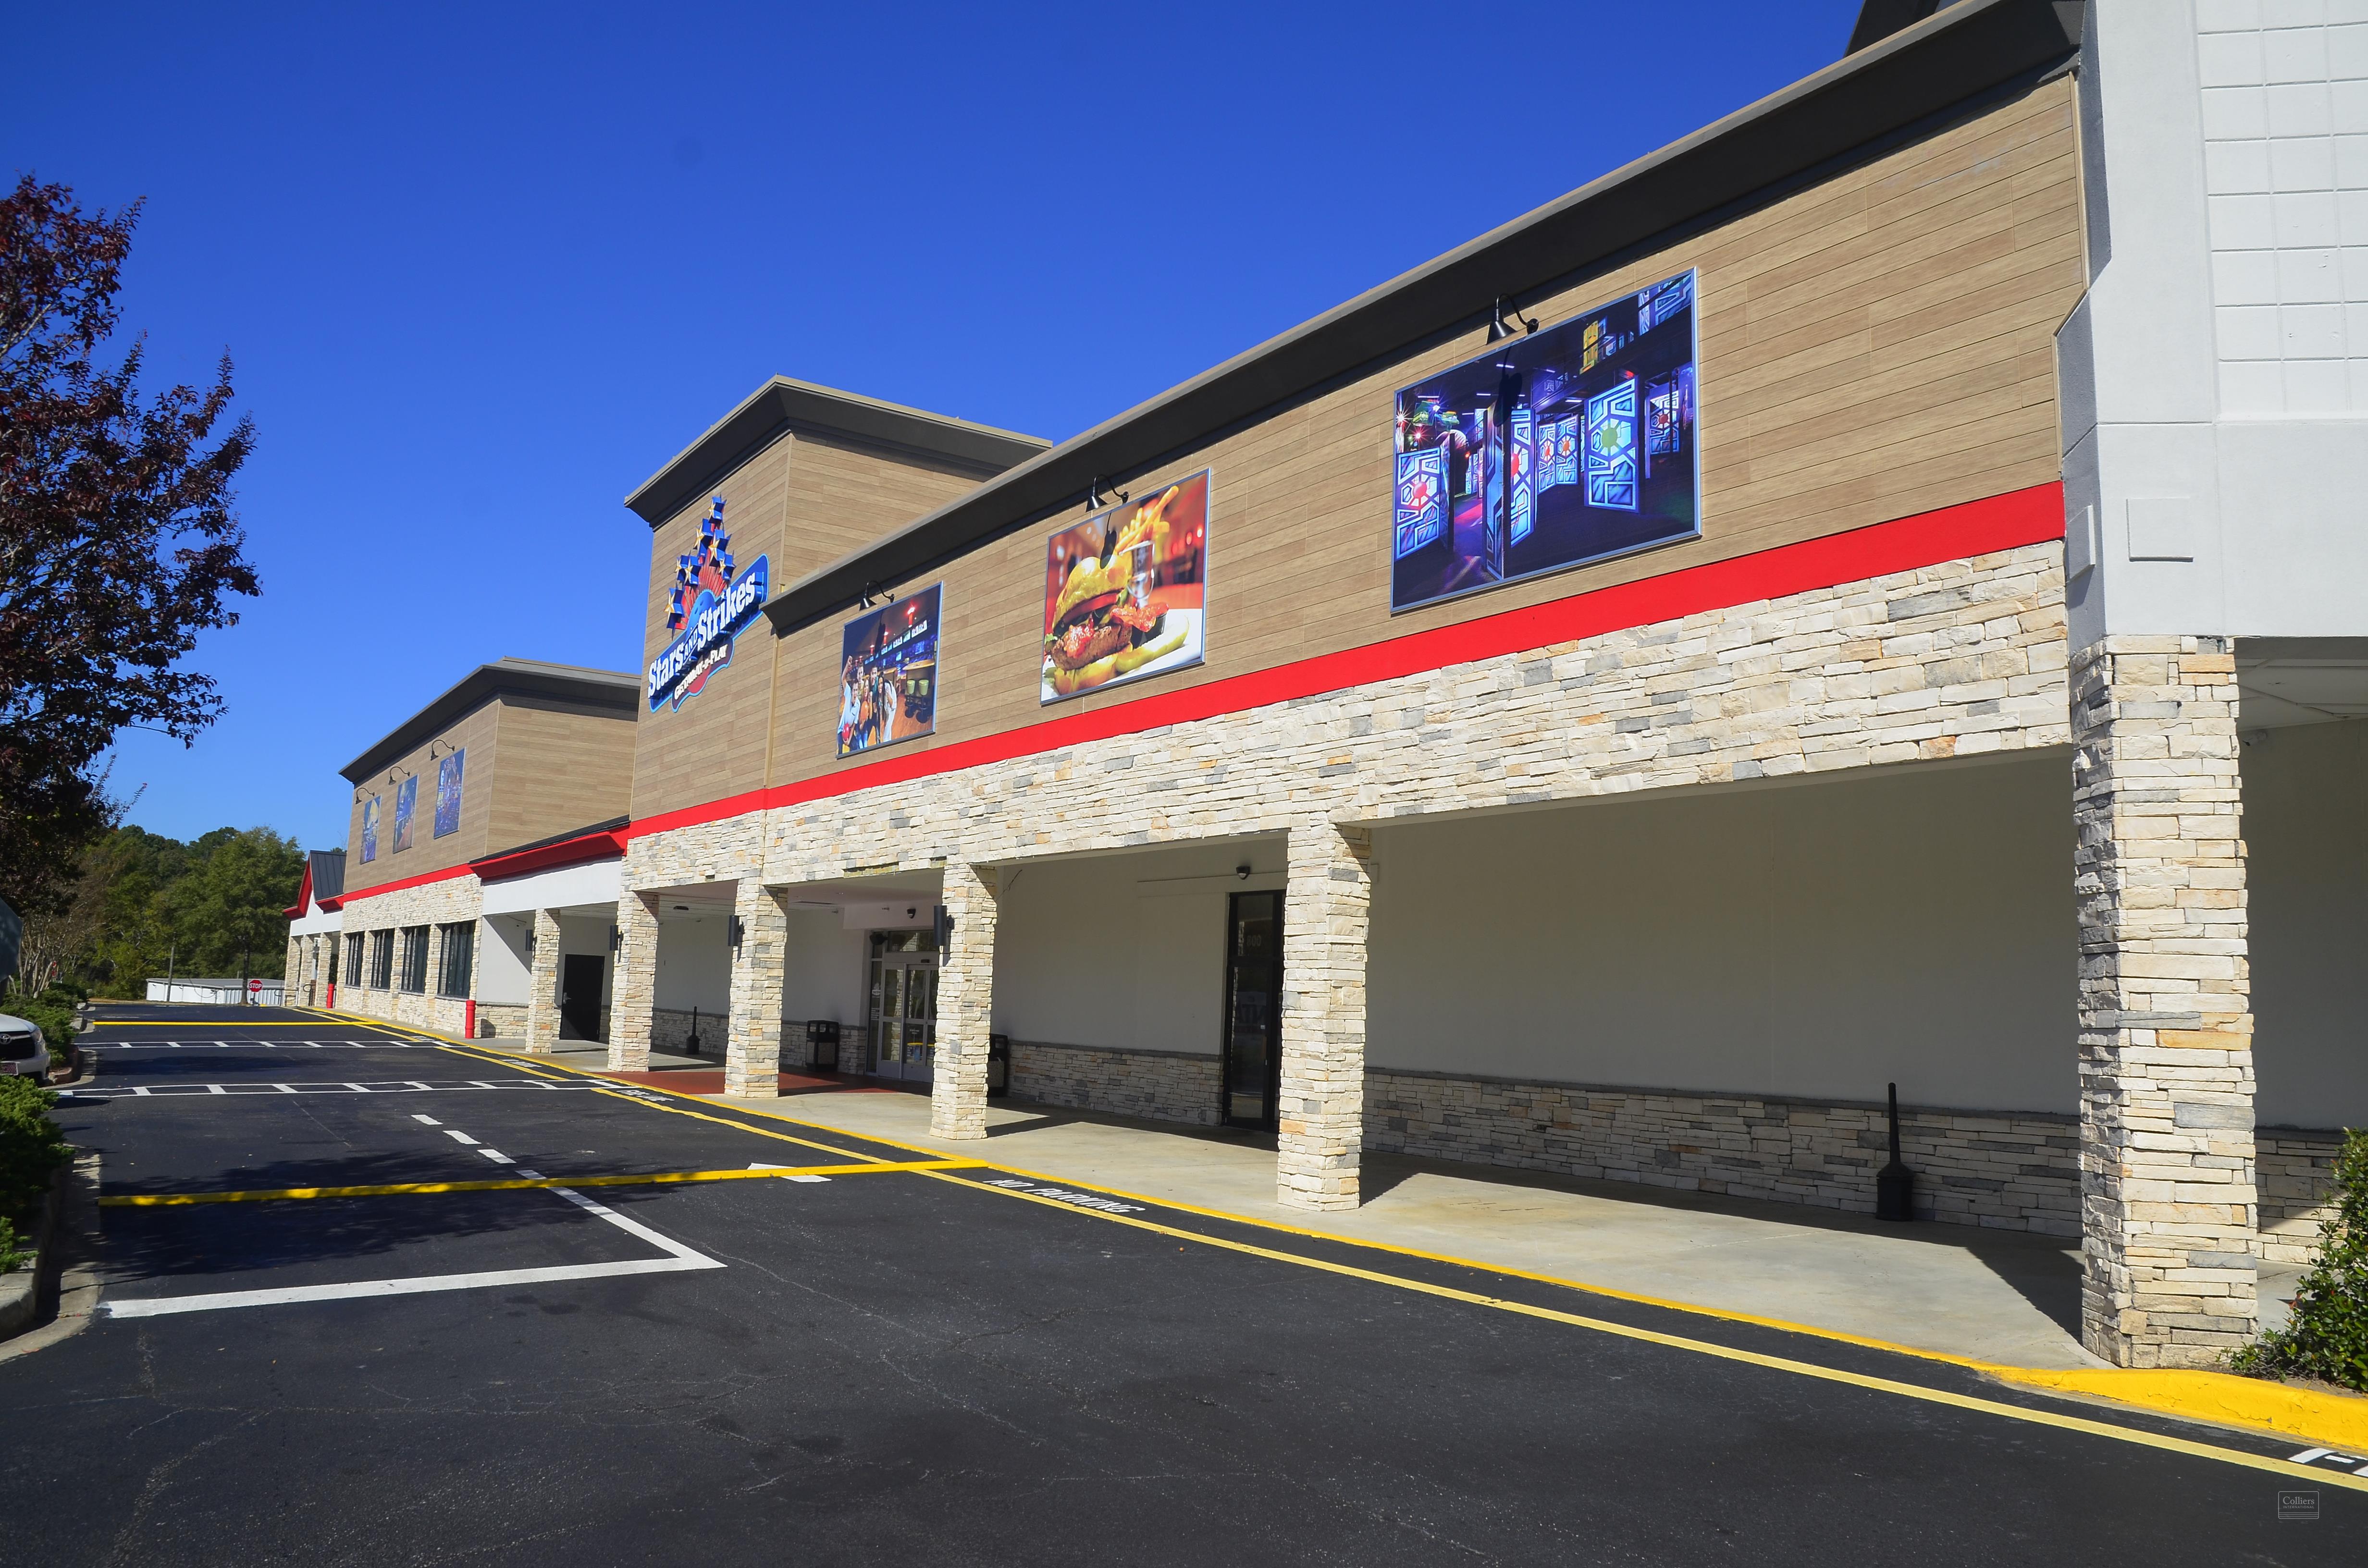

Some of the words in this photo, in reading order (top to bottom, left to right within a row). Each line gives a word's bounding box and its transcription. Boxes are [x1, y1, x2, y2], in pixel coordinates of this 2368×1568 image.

[648, 642, 684, 698] Stars
[684, 628, 698, 661] AND
[698, 572, 755, 651] Strikes
[982, 1179, 1035, 1188] NO
[1022, 1188, 1146, 1213] PARKING
